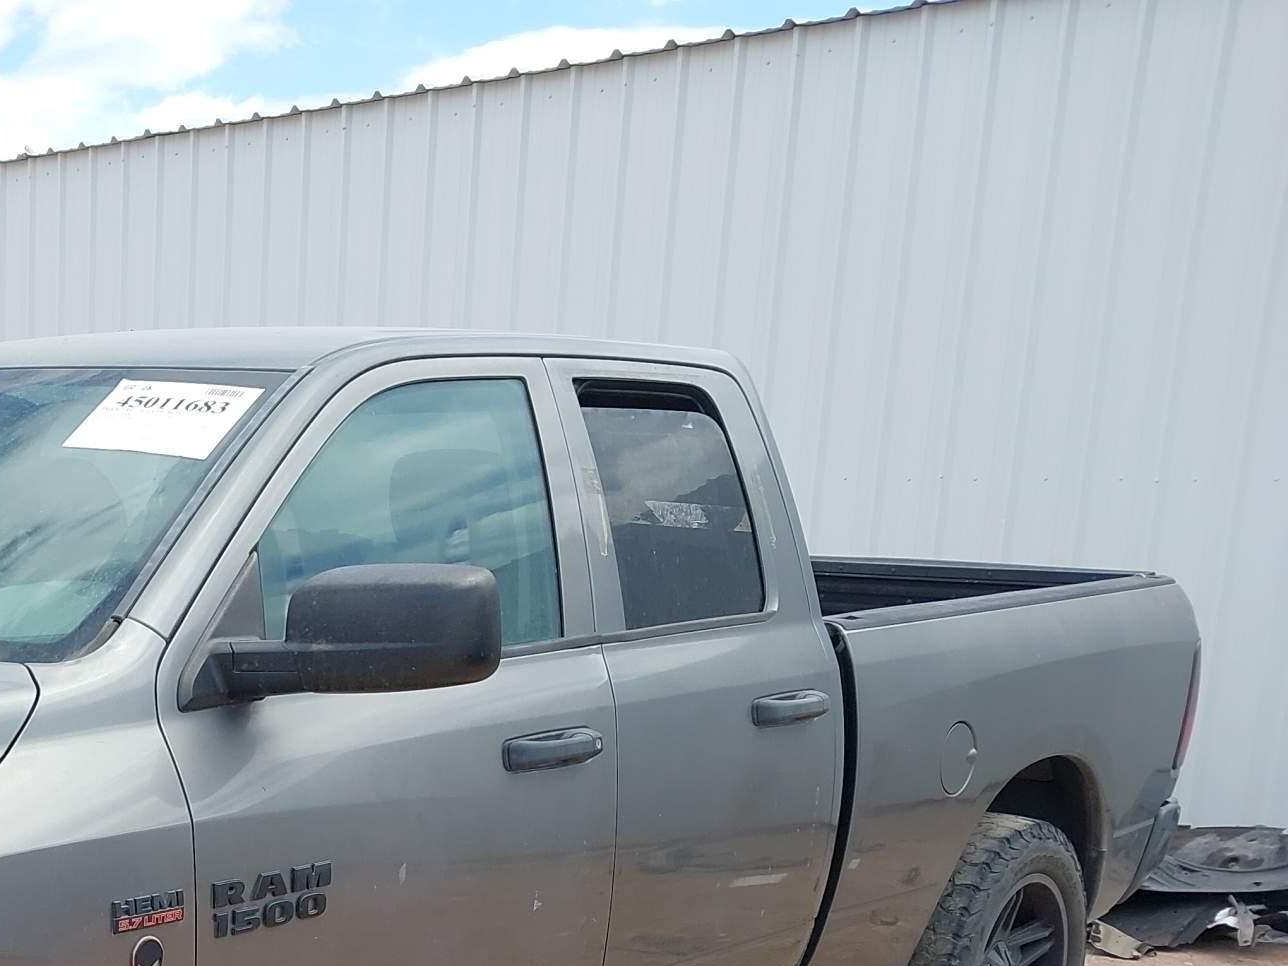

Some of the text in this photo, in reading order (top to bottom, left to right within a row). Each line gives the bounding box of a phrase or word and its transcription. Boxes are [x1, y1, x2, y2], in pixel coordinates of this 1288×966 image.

[116, 395, 230, 414] 45011683
[210, 860, 333, 909] RAM
[112, 888, 185, 919] HEMI
[212, 892, 328, 939] 1500
[118, 909, 184, 932] 5.7 LITER
